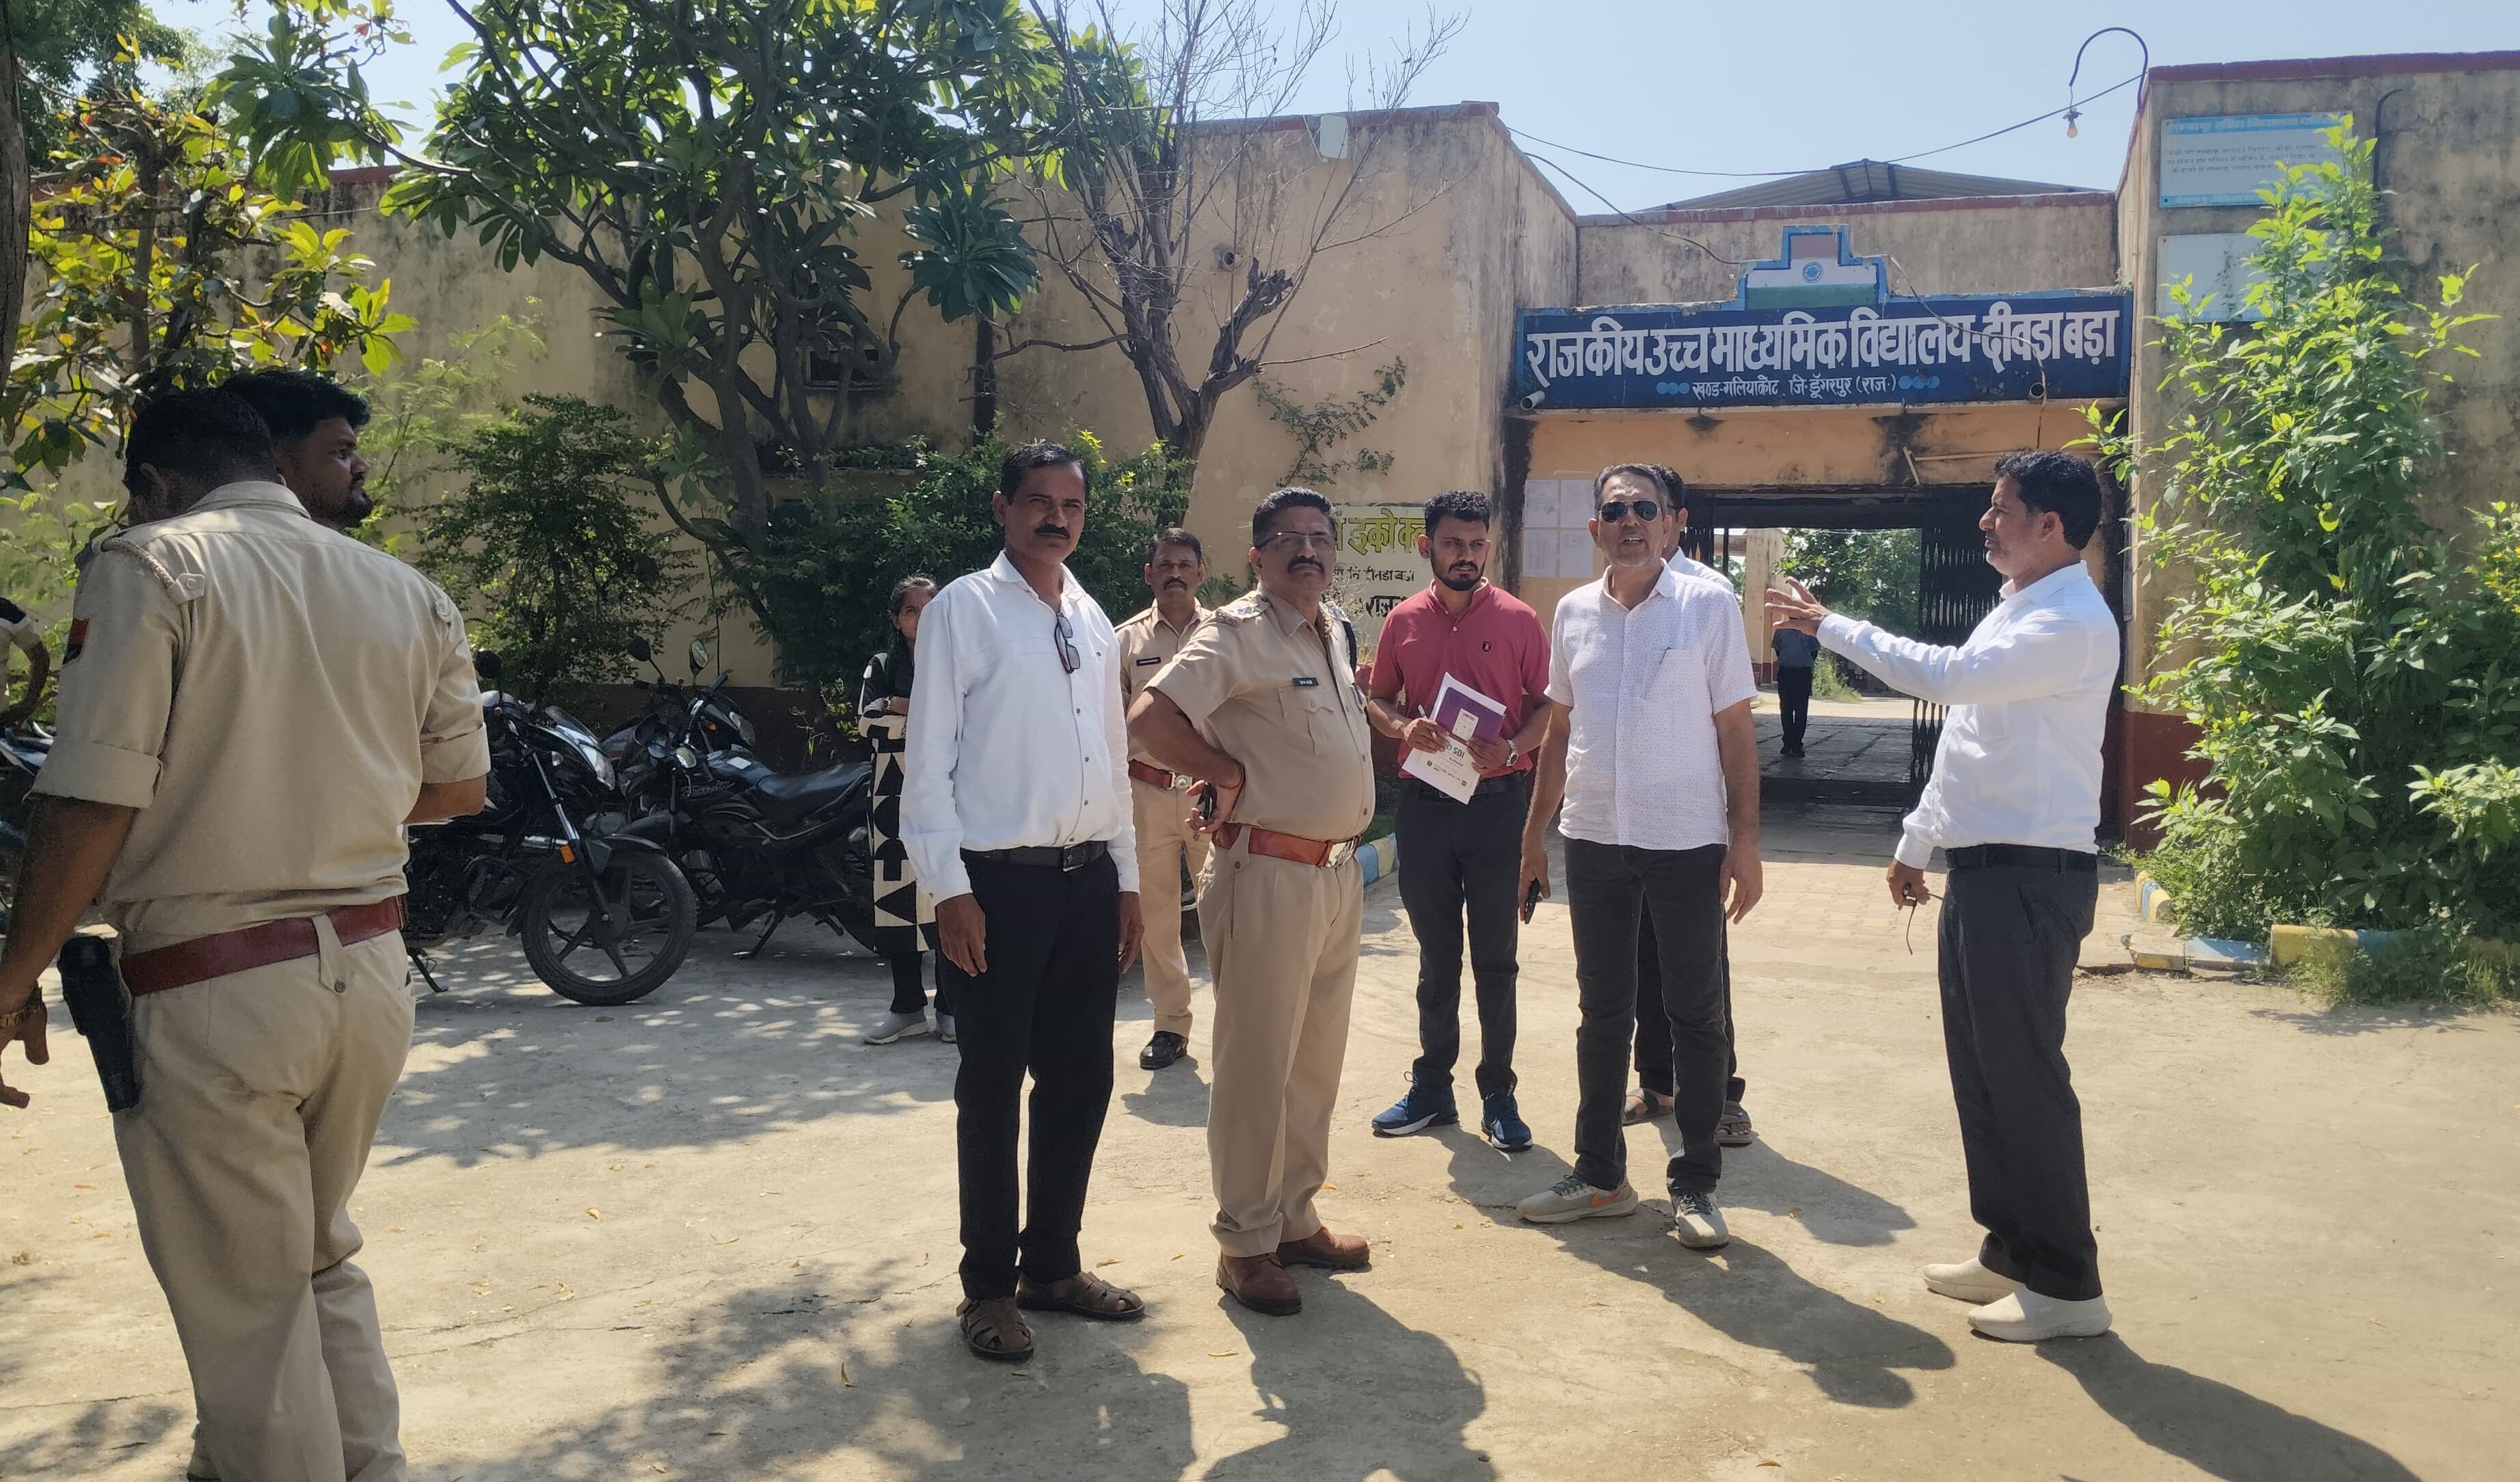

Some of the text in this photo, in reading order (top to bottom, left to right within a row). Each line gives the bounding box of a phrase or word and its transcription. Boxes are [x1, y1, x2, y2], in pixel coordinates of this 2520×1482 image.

[1527, 316, 1648, 388] राजकीय
[1645, 327, 1711, 375] उच्च
[1711, 310, 1847, 373] माध्यमिक
[2063, 310, 2120, 365] बड़ा
[1453, 746, 1465, 759] SBI
